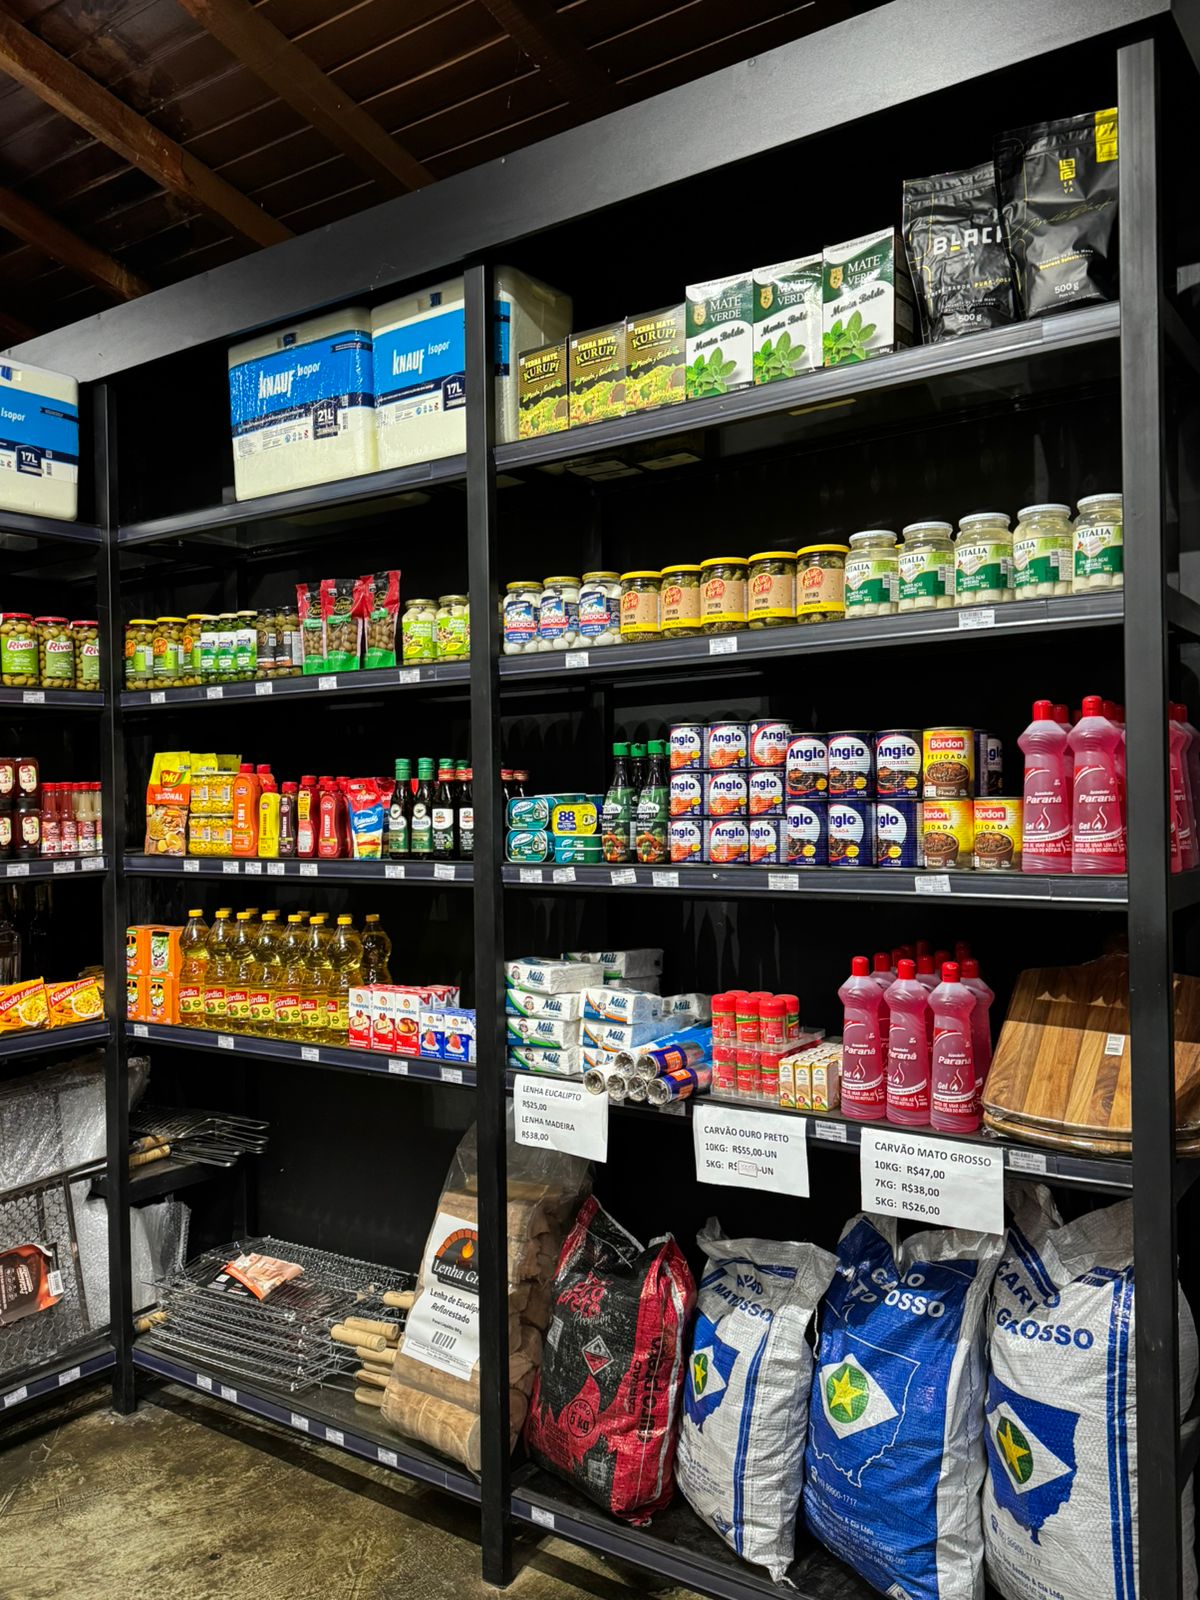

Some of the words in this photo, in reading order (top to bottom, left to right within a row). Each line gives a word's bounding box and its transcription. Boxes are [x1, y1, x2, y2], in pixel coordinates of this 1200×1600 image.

[848, 255, 881, 274] MATE
[859, 287, 886, 306] Boldo
[710, 297, 741, 312] MATE
[710, 309, 742, 323] VERDE
[720, 326, 745, 342] Boldo
[446, 382, 463, 395] 17L
[1, 407, 26, 422] Isopor
[21, 451, 38, 464] 17L
[1077, 527, 1112, 539] VITALIA
[957, 547, 988, 558] VITALIA
[8, 641, 33, 650] Rivoli
[712, 733, 742, 744] Anglo
[761, 730, 790, 742] Angl
[931, 738, 964, 748] Bordon
[788, 746, 826, 762] Anglo
[829, 745, 865, 760] Anglo
[878, 744, 915, 760] Anglo
[713, 780, 743, 792] Anglo
[1026, 795, 1062, 804] Paraná
[558, 811, 576, 822] 88
[787, 814, 813, 828] nglo
[829, 813, 856, 828] nglo
[1025, 821, 1035, 830] Gel
[1078, 822, 1091, 830] Gel
[715, 827, 745, 839] Anglo
[750, 827, 771, 839] nglo
[600, 952, 617, 964] Mili
[526, 970, 544, 982] Mili
[51, 986, 74, 1005] Nissin
[609, 996, 628, 1008] Mili
[542, 1000, 562, 1012] Mili
[673, 1000, 691, 1011] Mili
[535, 1021, 554, 1034] Mili
[606, 1029, 625, 1041] Mili
[542, 1051, 560, 1063] Mili
[844, 1046, 876, 1056] Paraná
[937, 1081, 948, 1090] Gel
[523, 1085, 544, 1095] LENHA
[545, 1088, 582, 1101] EUCALIPTO
[522, 1100, 547, 1111] R$25,00
[521, 1115, 544, 1125] LENHA
[545, 1119, 575, 1131] MADEIRA
[704, 1126, 737, 1137] CARVÃO
[739, 1129, 762, 1140] OURO
[764, 1132, 789, 1143] PRETO
[705, 1142, 729, 1153] 10KG:
[732, 1145, 777, 1159] R$55,00-UN
[875, 1141, 915, 1156] CARVÃO
[917, 1147, 948, 1161] MATO
[950, 1152, 992, 1167] GROSSO
[706, 1159, 724, 1169] 5KG:
[874, 1160, 902, 1173] 10KG:
[907, 1165, 945, 1180] R$47,00
[874, 1179, 897, 1190] 7KG:
[901, 1183, 940, 1198] R$38,00
[875, 1197, 897, 1209] 5KG:
[902, 1201, 940, 1216] R$26,00
[433, 1260, 463, 1280] Lenha
[430, 1288, 449, 1302] Lenha
[447, 1295, 457, 1305] de
[884, 1289, 946, 1318] OSSO
[430, 1302, 471, 1325] Reflorestado
